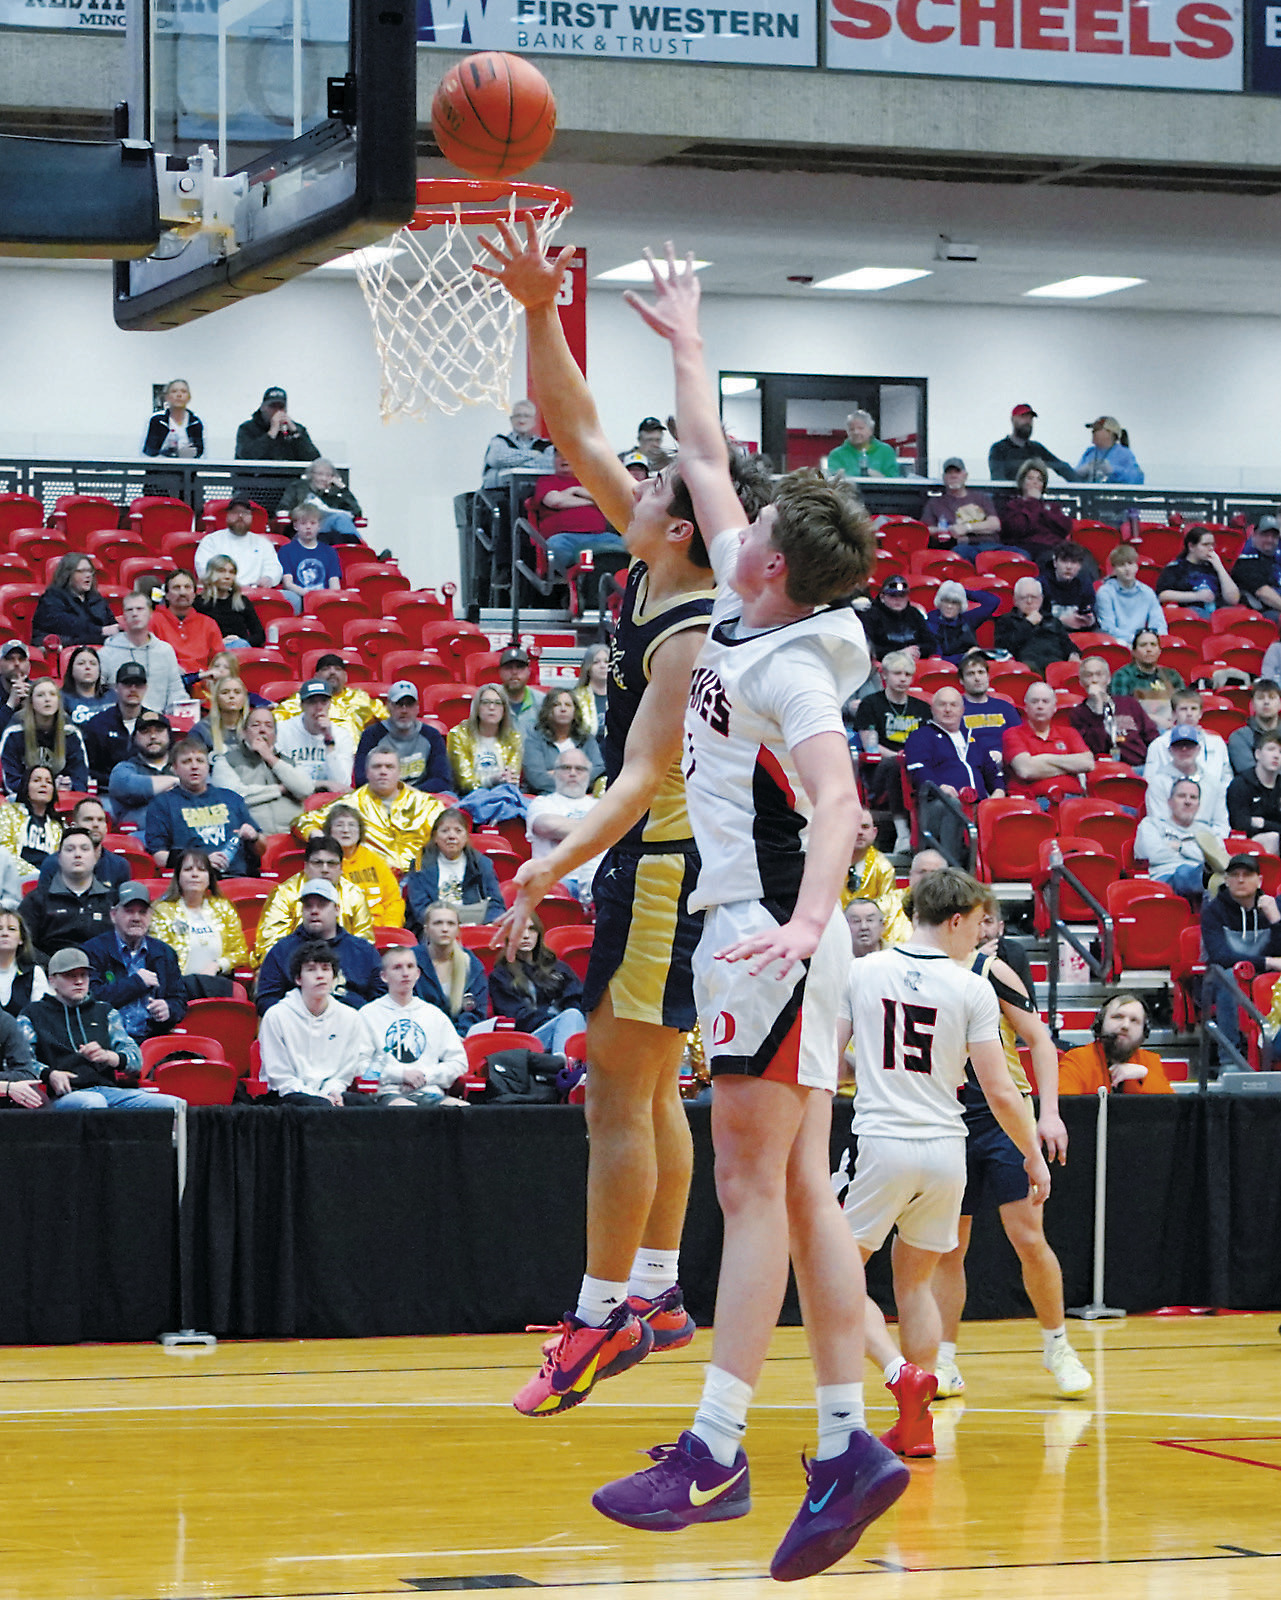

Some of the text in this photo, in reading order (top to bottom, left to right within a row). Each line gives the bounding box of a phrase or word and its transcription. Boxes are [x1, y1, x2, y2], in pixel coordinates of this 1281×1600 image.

[517, 0, 799, 38] FIRST WESTERN
[517, 31, 693, 54] BANK & TRUST
[830, 0, 1235, 59] SCHEELS
[881, 998, 938, 1075] 15
